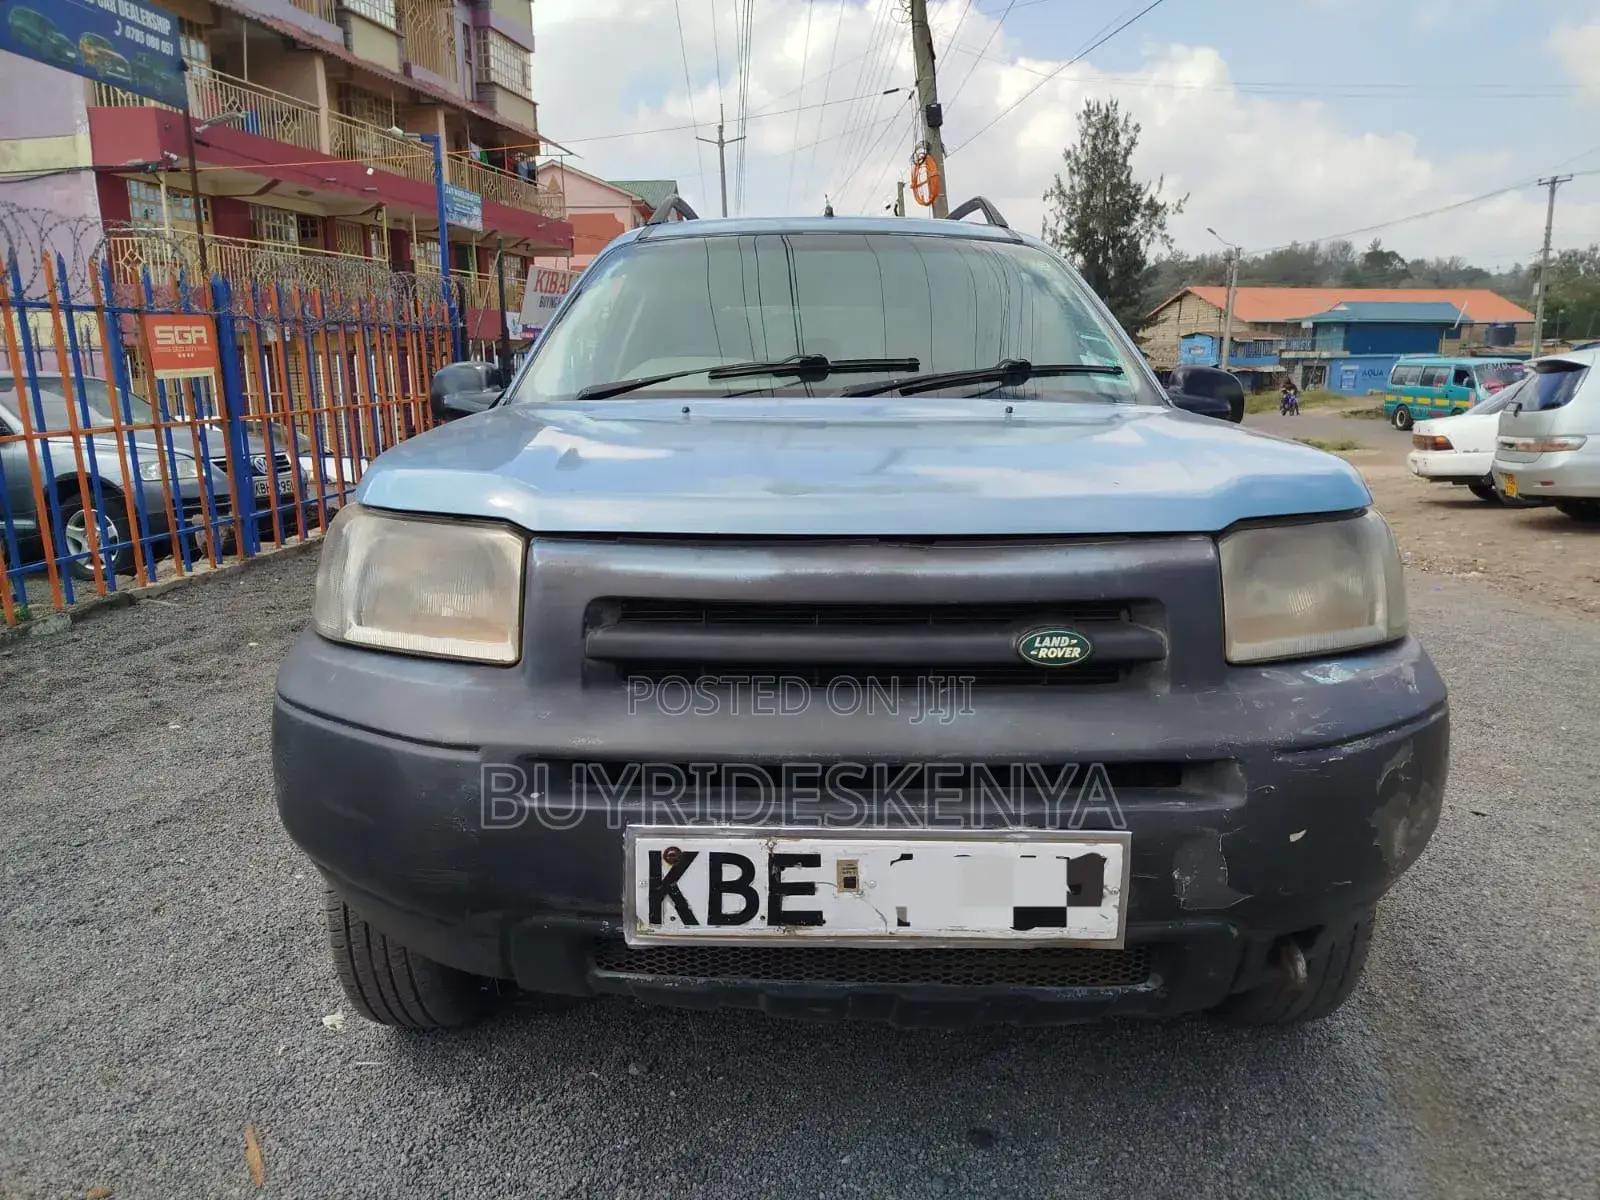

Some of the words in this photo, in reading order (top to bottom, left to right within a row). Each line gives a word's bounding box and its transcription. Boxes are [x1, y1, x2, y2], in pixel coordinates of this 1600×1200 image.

[117, 0, 171, 36] DEALERSHIP
[154, 325, 208, 345] SGA
[1362, 368, 1384, 378] AQUA
[1034, 636, 1070, 647] LAND
[1037, 647, 1081, 659] ROVER
[648, 850, 827, 927] KBE
